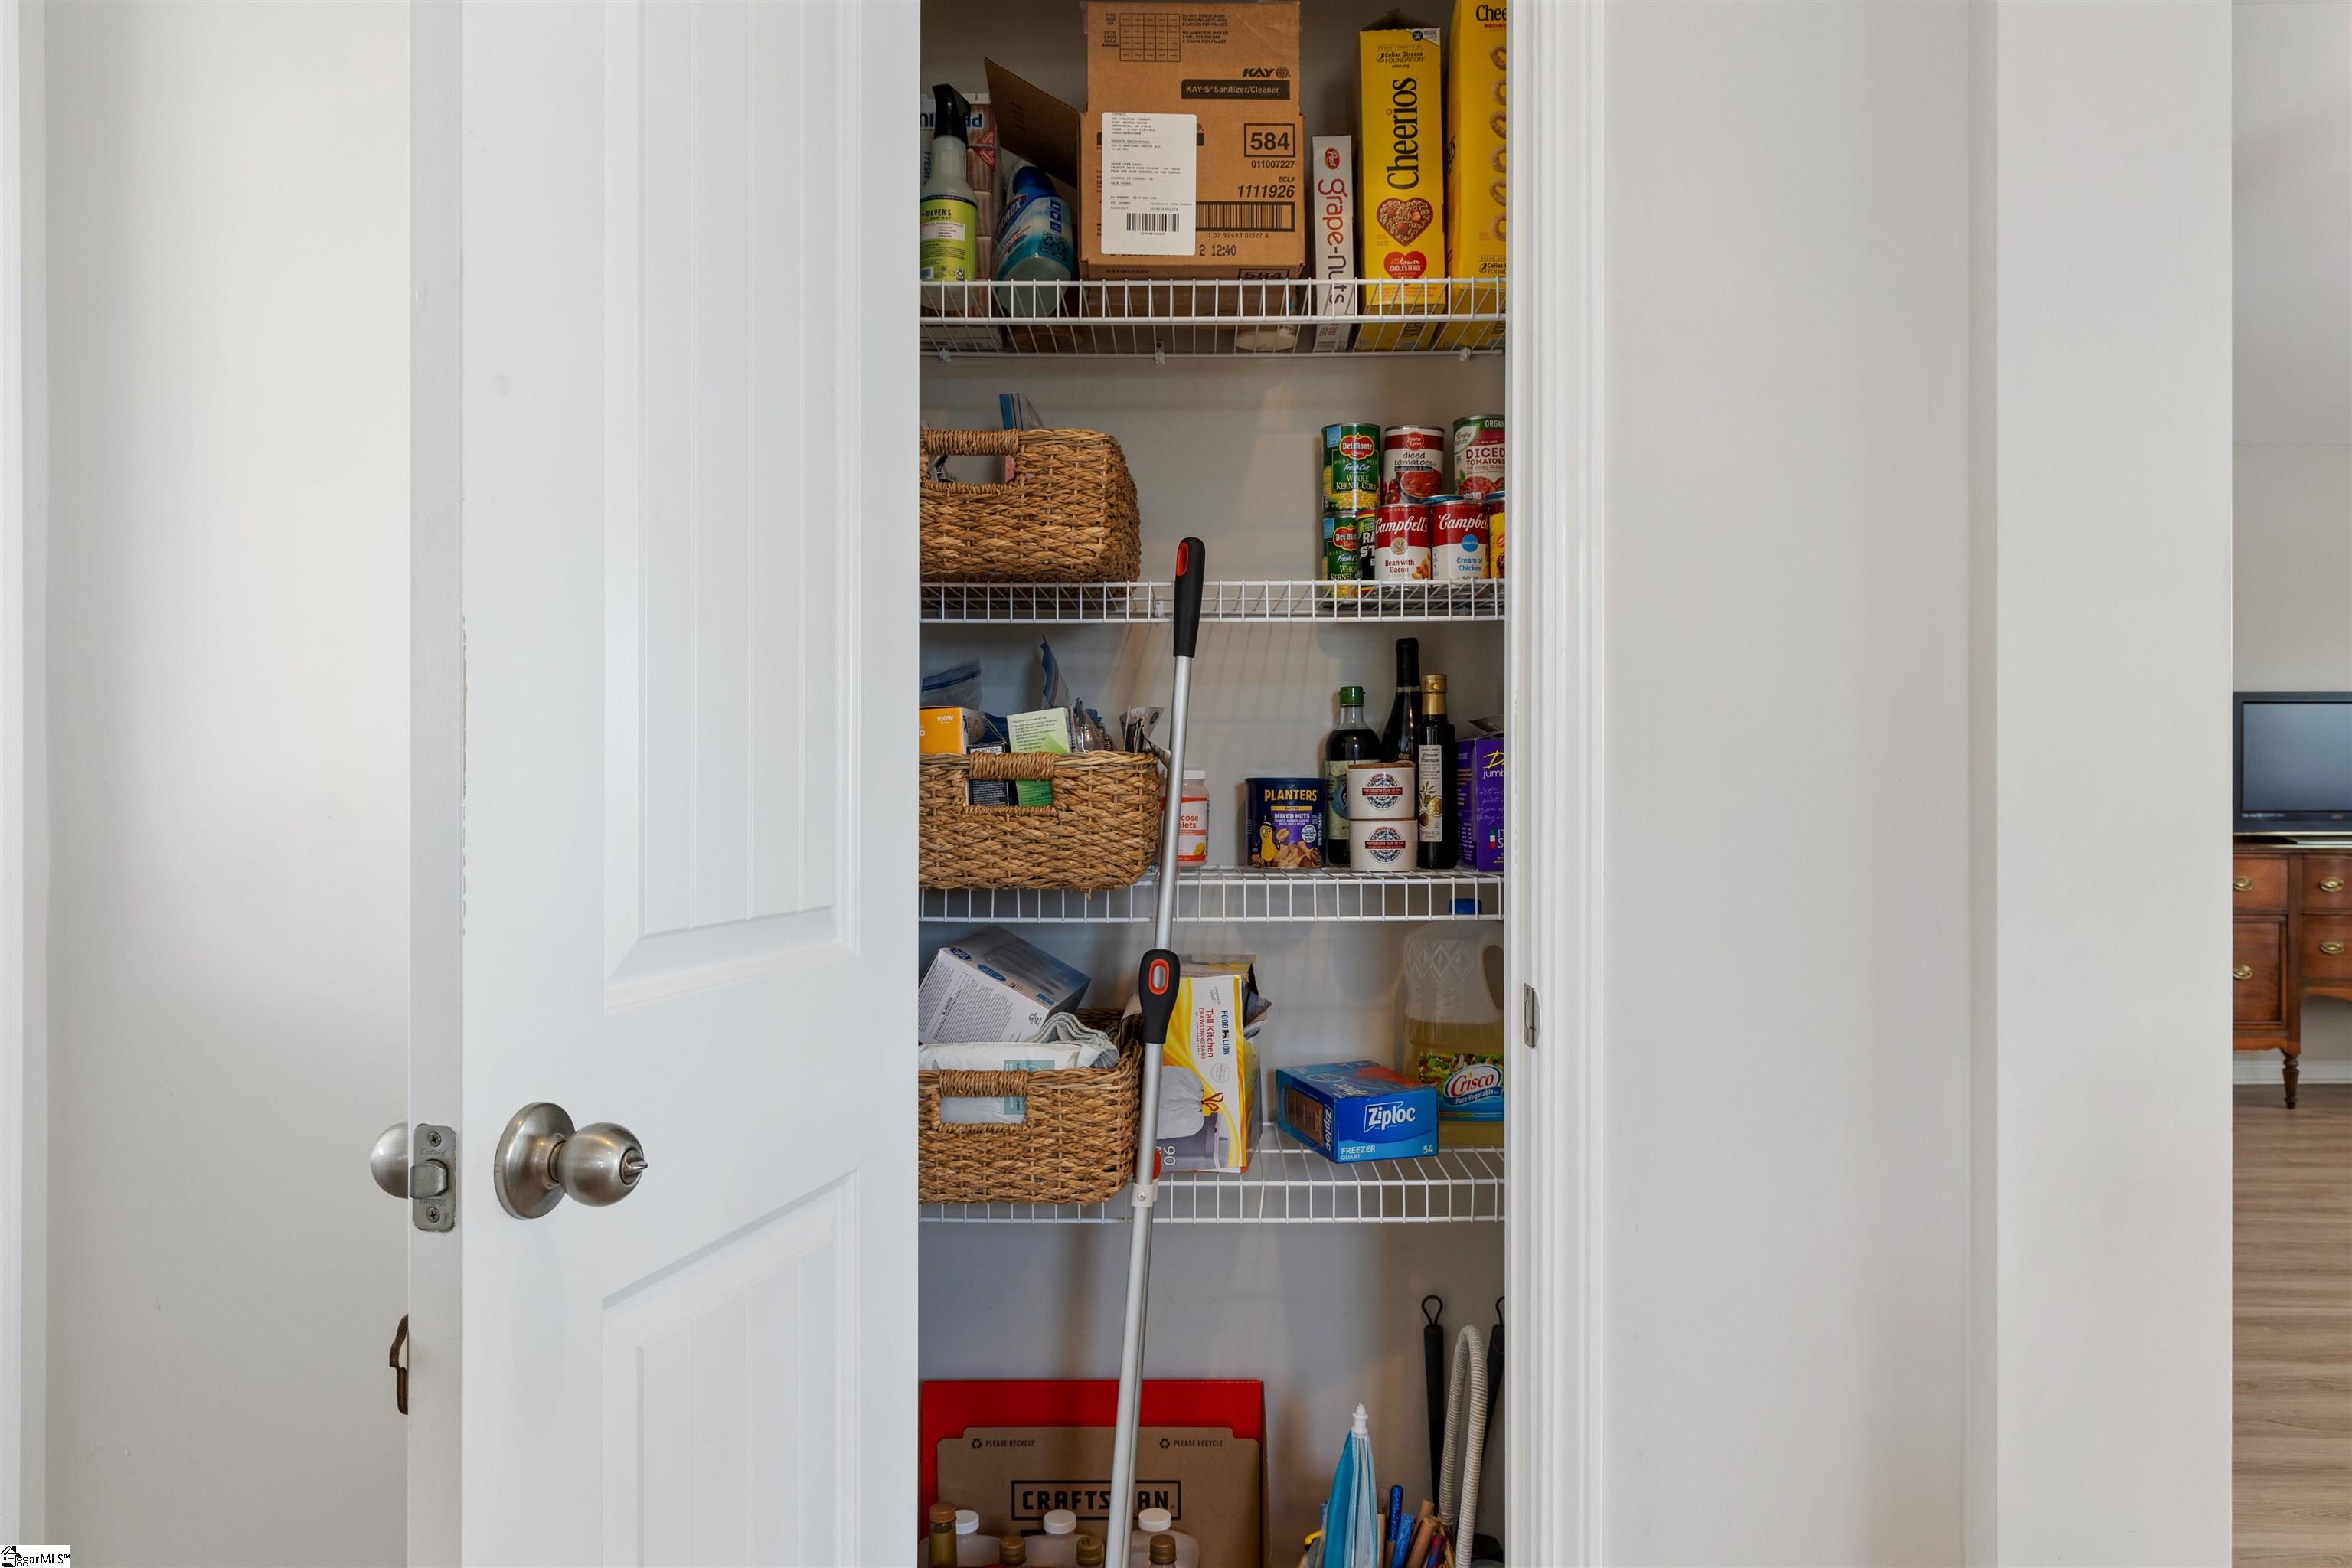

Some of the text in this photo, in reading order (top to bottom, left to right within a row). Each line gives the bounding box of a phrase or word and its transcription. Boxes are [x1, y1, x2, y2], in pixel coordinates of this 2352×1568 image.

[1242, 67, 1275, 77] KAY
[1386, 77, 1419, 190] Cheerios
[1250, 132, 1290, 150] 584
[1251, 160, 1295, 168] 011007227
[1237, 185, 1295, 198] 1111926
[1318, 178, 1348, 305] grape-nuts
[1211, 245, 1236, 256] 12:40
[1466, 448, 1505, 459] DICED
[1343, 463, 1358, 472] Fresh
[1346, 473, 1369, 482] WHOLE
[1336, 482, 1377, 490] KERNEL CORN
[1375, 516, 1427, 534] Campbell's
[1337, 554, 1351, 563] Fresh
[1265, 789, 1317, 802] PLANTERS
[1205, 1009, 1214, 1024] Tall
[1450, 1074, 1494, 1096] Crisco
[1468, 1089, 1494, 1101] Vegetable
[1368, 1106, 1416, 1131] Ziploc
[1323, 1109, 1332, 1152] Ziploc
[1163, 1145, 1176, 1165] 90
[1341, 1145, 1376, 1154] FREEZER
[1423, 1145, 1433, 1154] 54
[1023, 1491, 1168, 1510] CRAFTSAN
